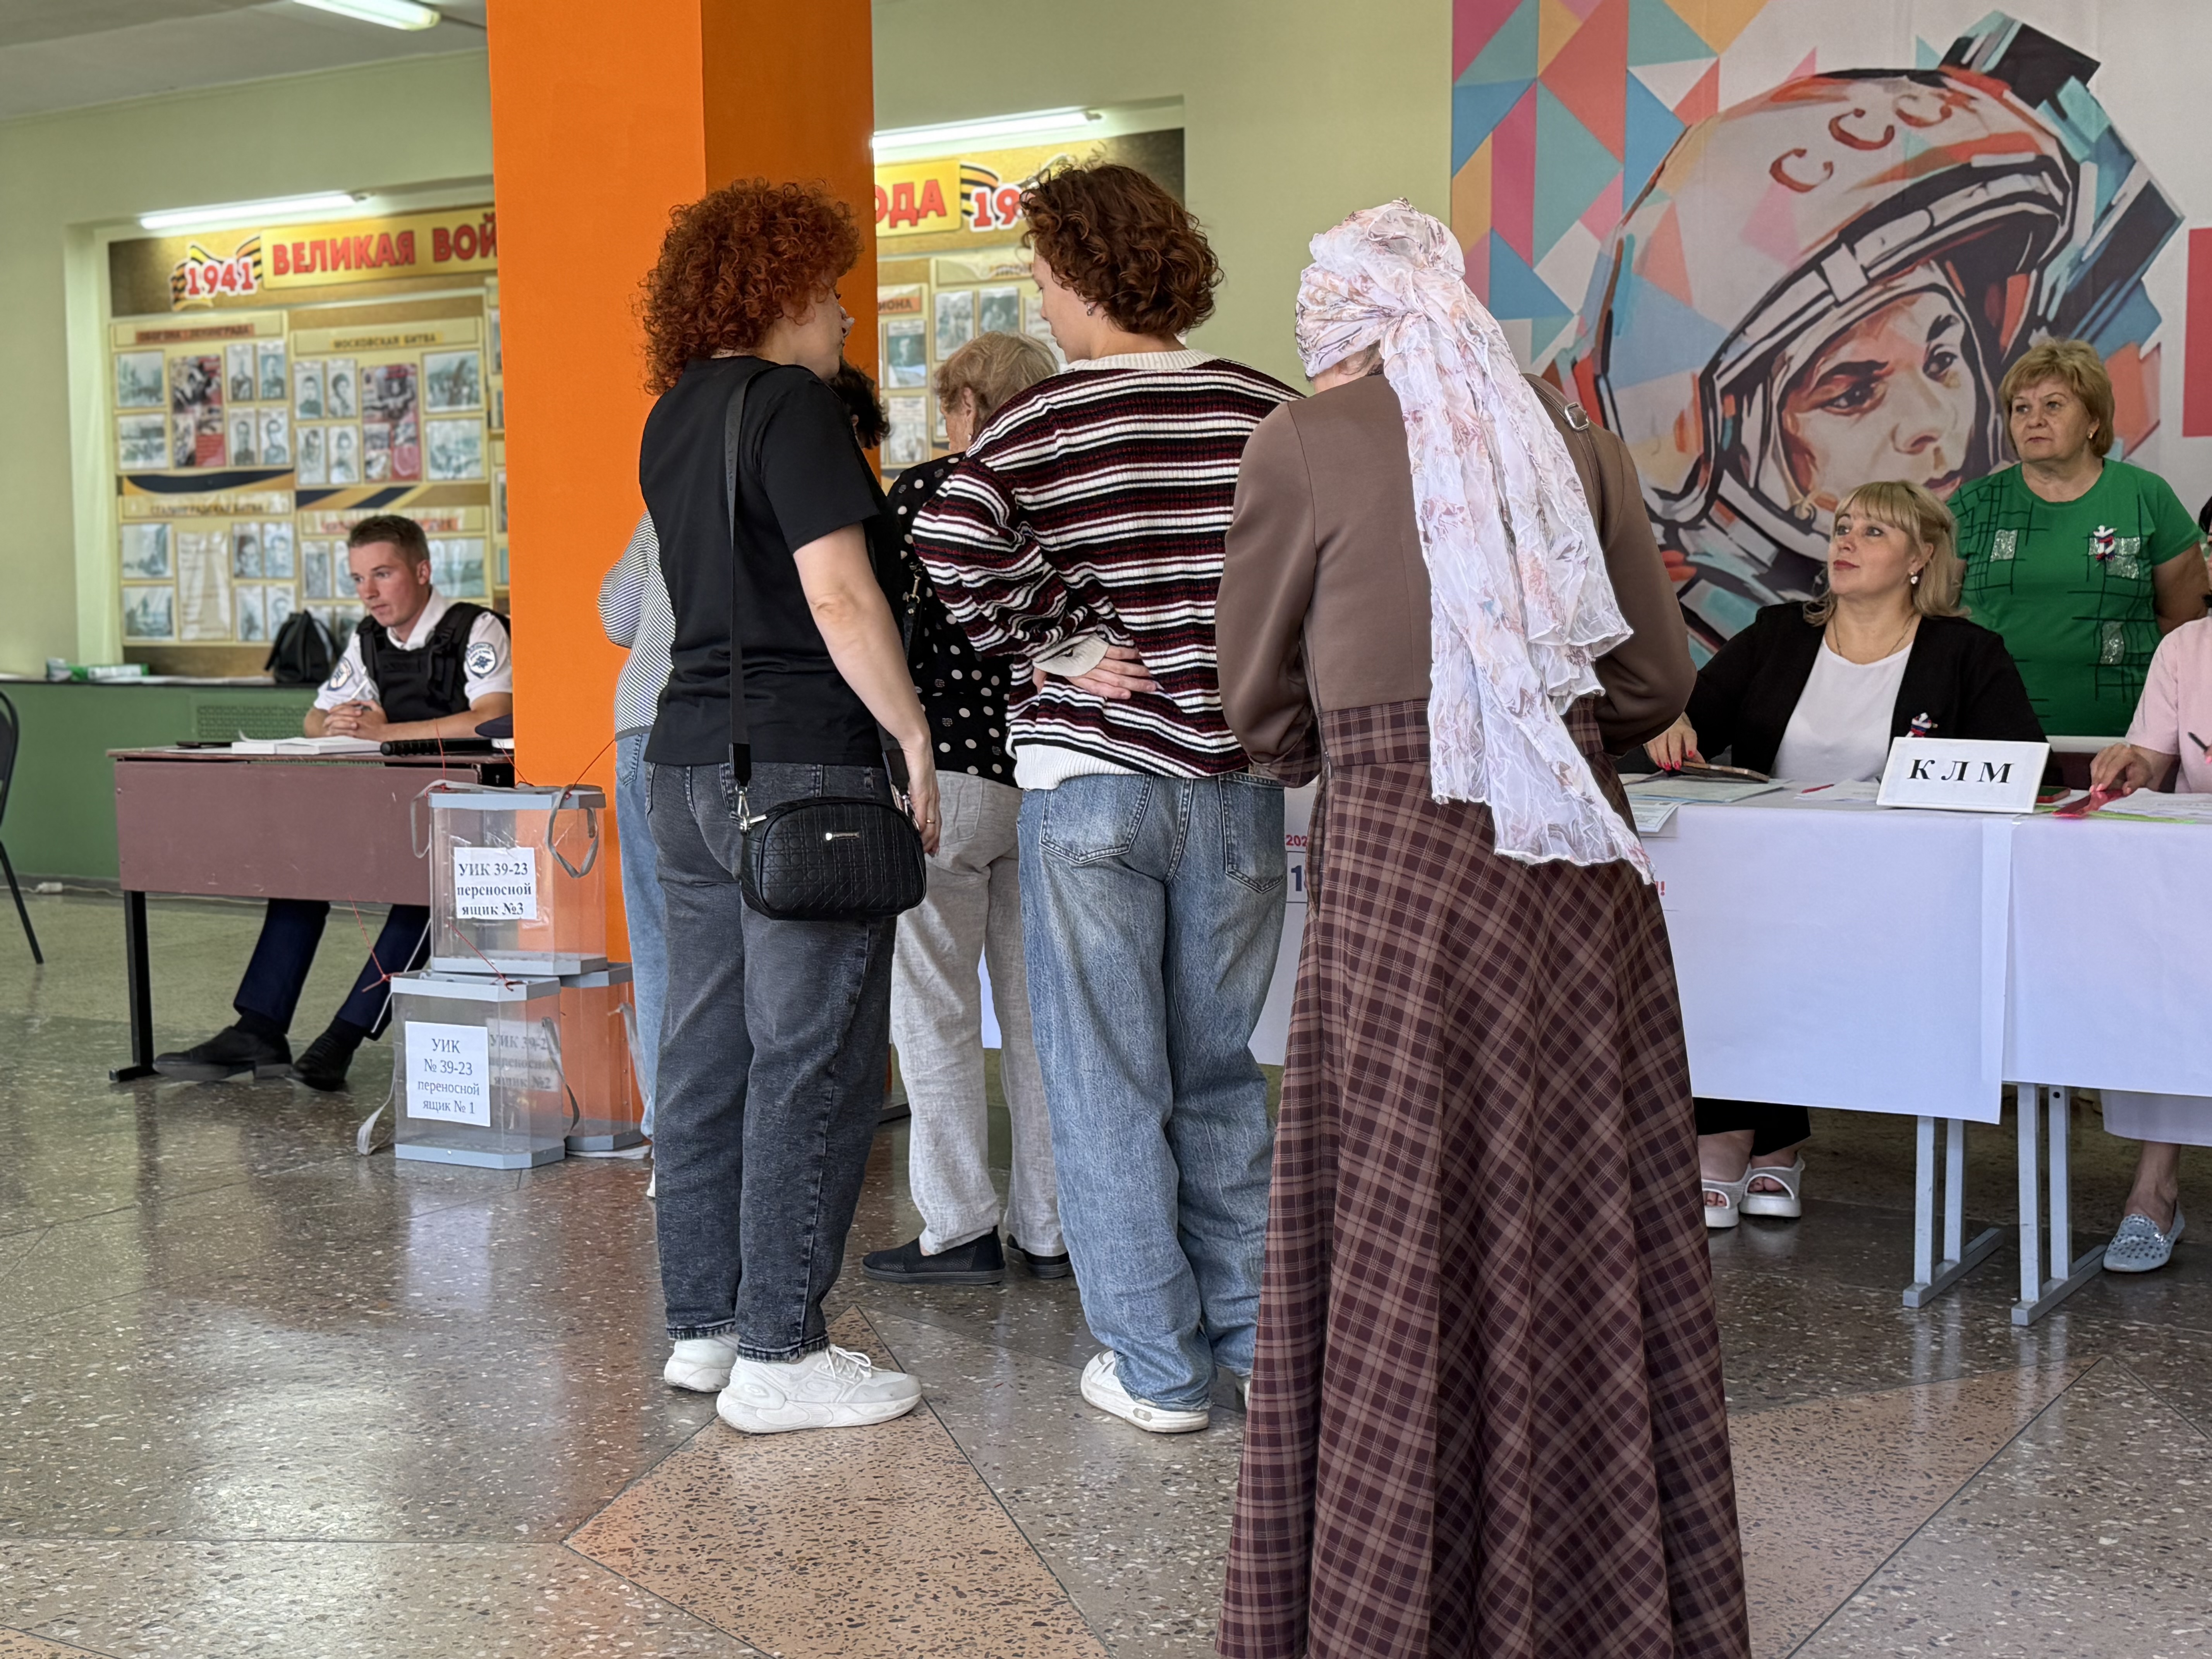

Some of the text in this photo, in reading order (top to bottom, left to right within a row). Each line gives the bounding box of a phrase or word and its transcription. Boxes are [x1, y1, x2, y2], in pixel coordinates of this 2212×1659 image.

[187, 262, 254, 295] 1941
[272, 230, 416, 276] ВЕЛИКАЯ
[404, 332, 436, 344] БИТВА
[459, 862, 528, 876] УИК 39-23
[1291, 865, 1305, 891] 1
[457, 883, 532, 899] переносной
[462, 902, 524, 916] ящик №3
[432, 1038, 461, 1054] УИК
[521, 1036, 547, 1051] 39-2
[424, 1058, 473, 1076] № 39-23
[418, 1081, 480, 1096] переносной
[422, 1100, 475, 1114] ящик № 1
